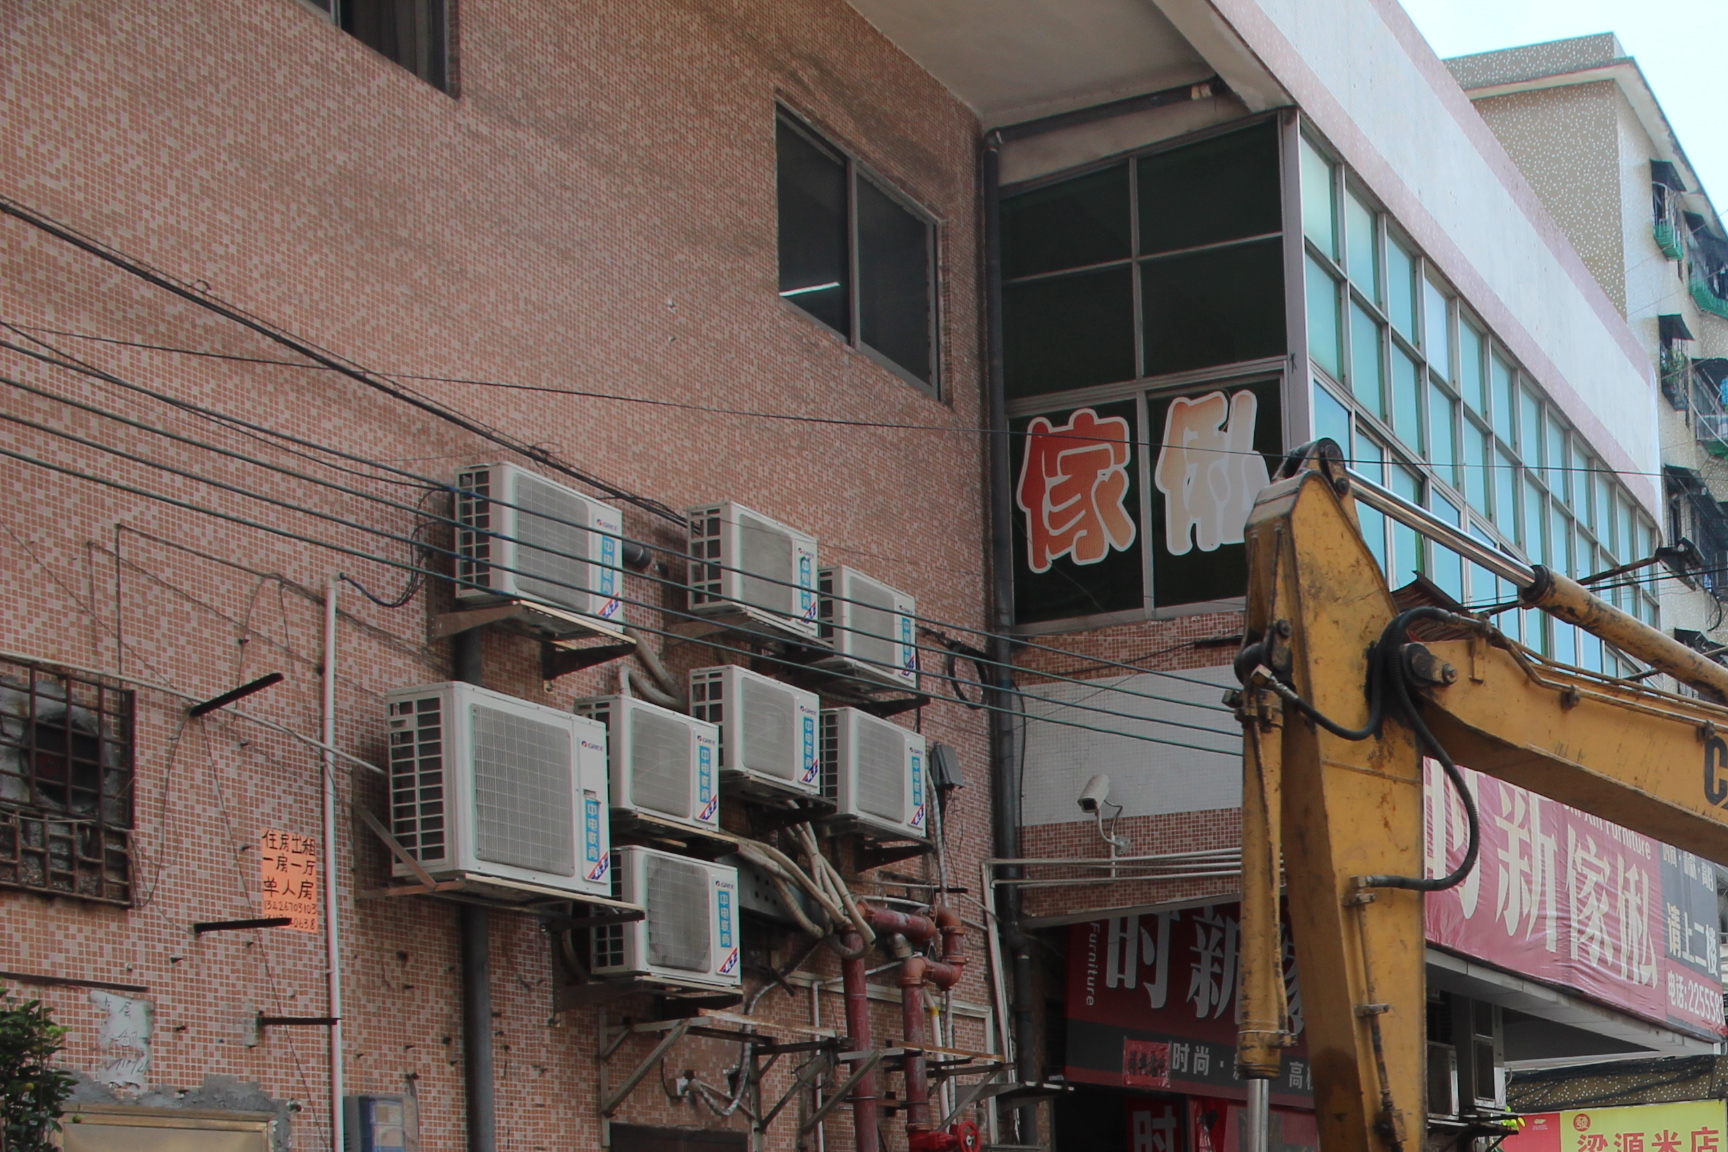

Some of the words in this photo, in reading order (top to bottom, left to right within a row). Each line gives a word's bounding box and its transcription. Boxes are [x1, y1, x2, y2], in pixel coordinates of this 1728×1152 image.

[263, 853, 316, 876] 一房一厅
[263, 876, 314, 899] 单人房
[1086, 922, 1100, 1006] Furniture
[1667, 902, 1719, 977] 请上二楼
